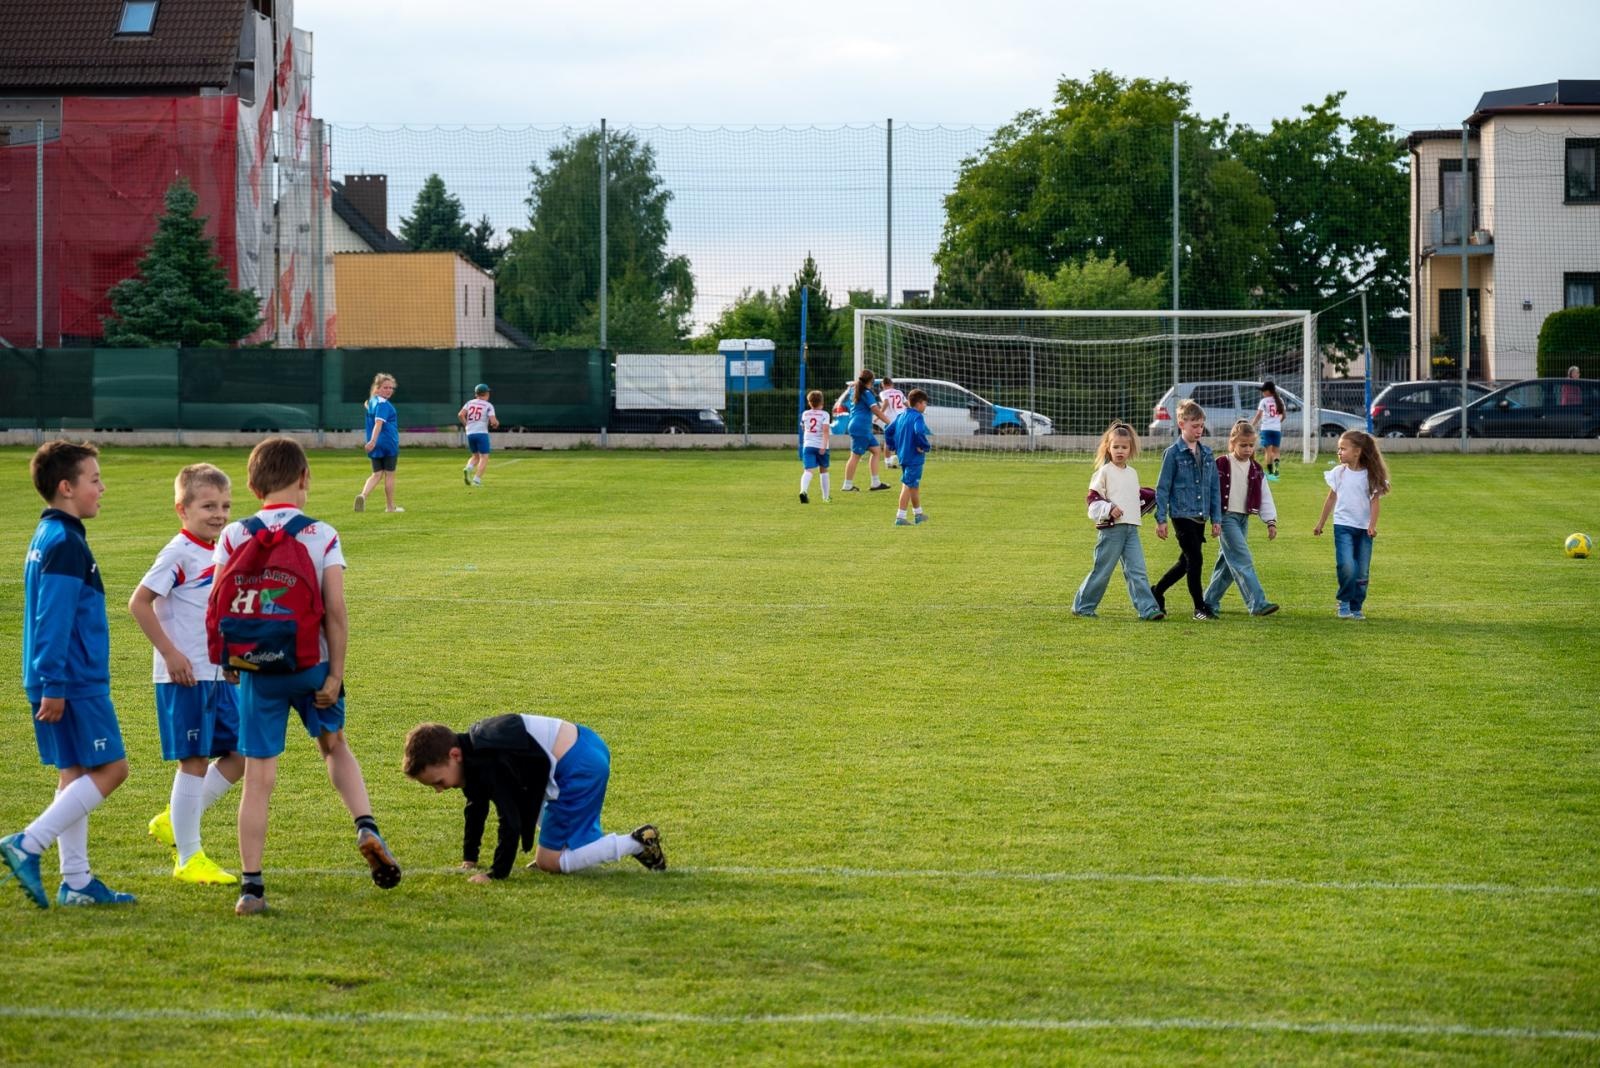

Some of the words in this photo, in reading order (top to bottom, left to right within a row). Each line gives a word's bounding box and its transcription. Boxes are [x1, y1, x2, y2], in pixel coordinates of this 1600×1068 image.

[889, 394, 902, 408] 72
[468, 406, 483, 421] 25
[810, 417, 817, 433] 2
[235, 569, 296, 586] HARTS
[230, 587, 258, 614] H
